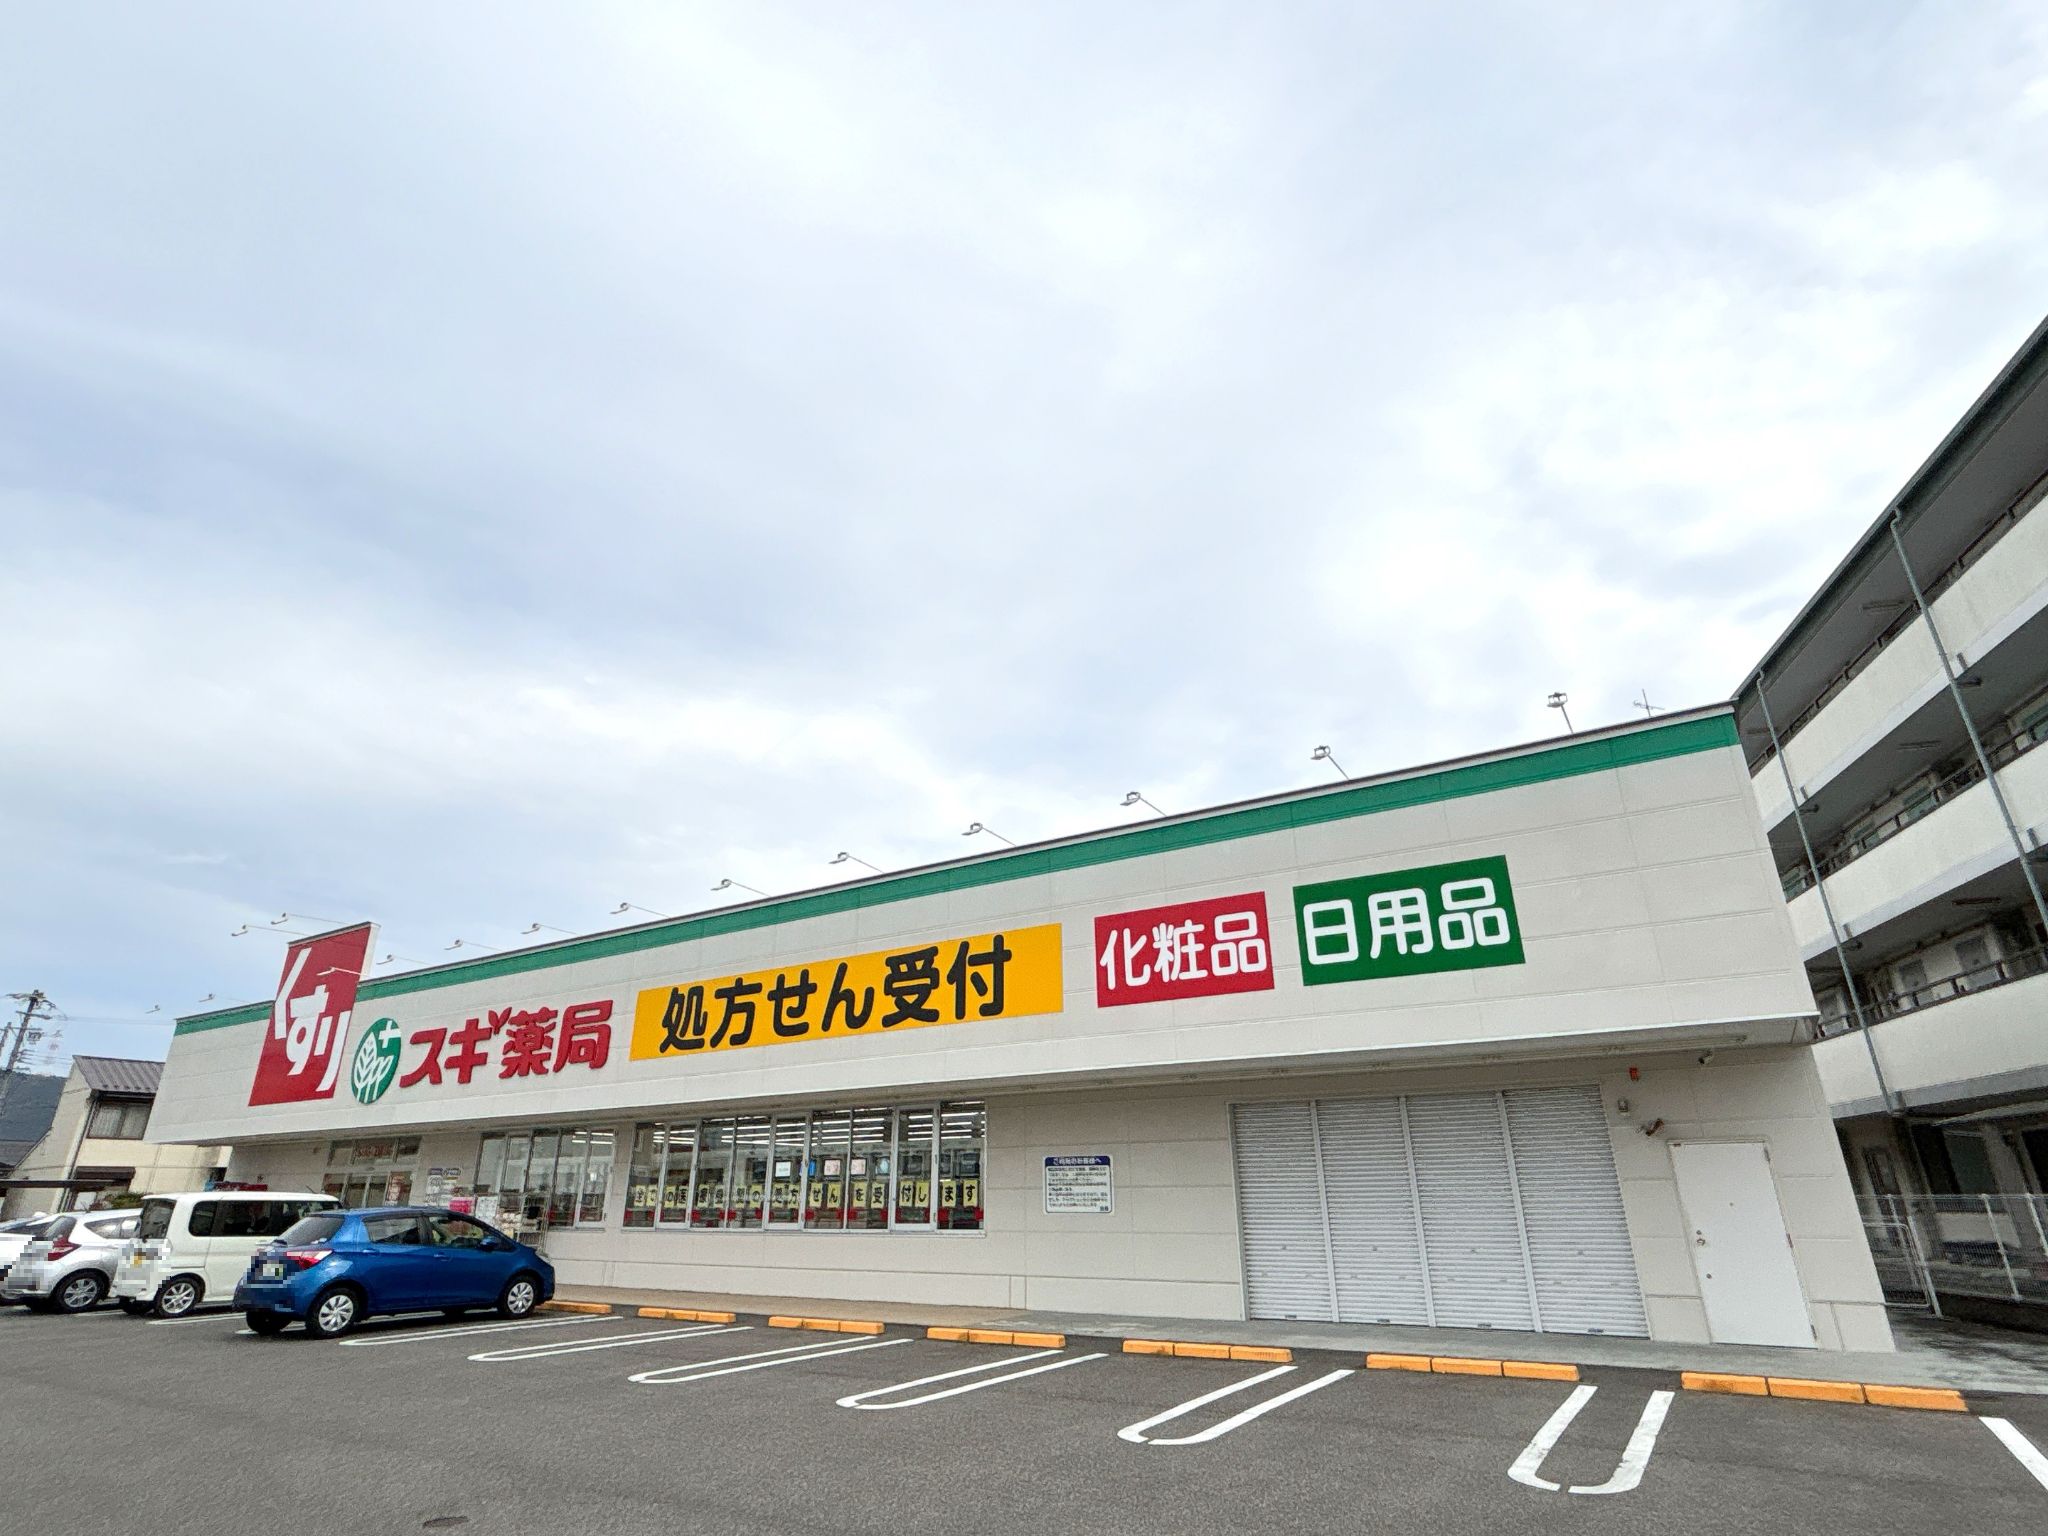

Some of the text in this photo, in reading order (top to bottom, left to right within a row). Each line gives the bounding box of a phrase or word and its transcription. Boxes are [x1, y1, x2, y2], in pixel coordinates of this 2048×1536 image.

[1099, 911, 1267, 990] 化粧品
[1303, 877, 1511, 966] 日用品
[274, 946, 352, 1092] くすり
[659, 934, 1012, 1053] 処方せん受付
[399, 999, 613, 1088] スギ薬局
